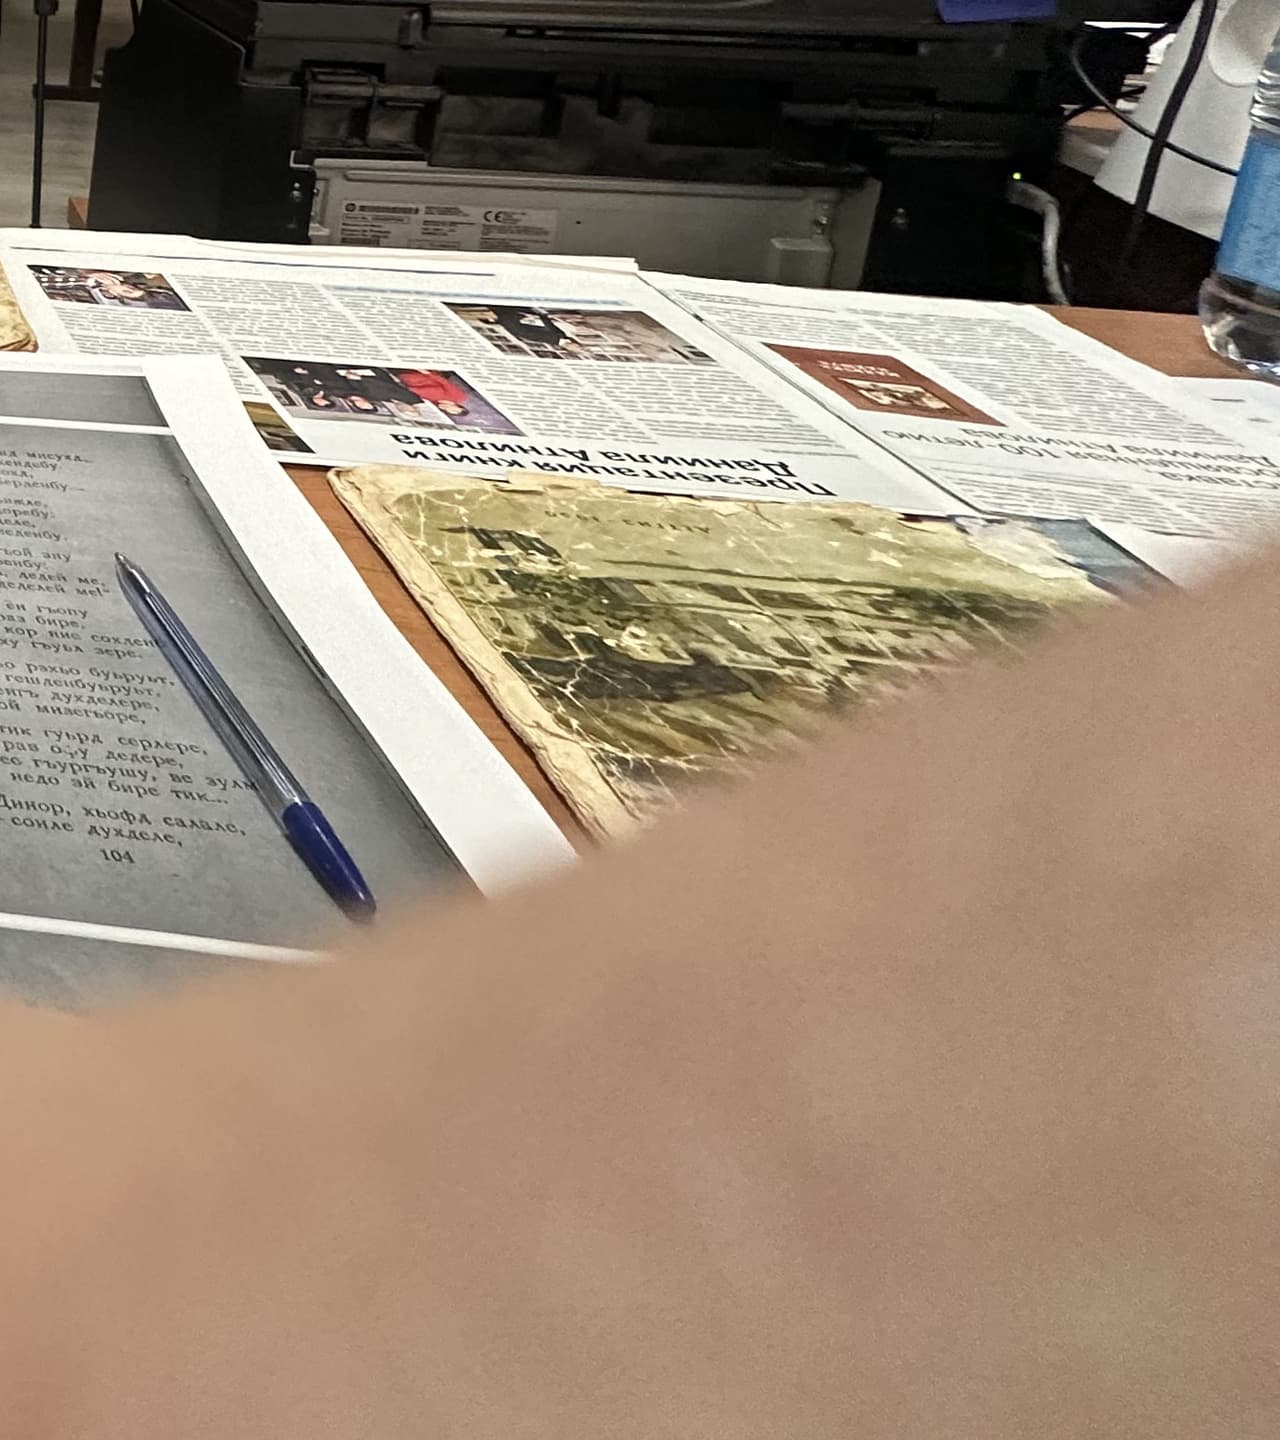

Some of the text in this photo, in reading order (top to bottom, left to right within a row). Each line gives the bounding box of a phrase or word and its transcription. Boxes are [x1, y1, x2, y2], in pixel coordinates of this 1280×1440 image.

[391, 434, 797, 477] Даниила Атнилова
[881, 430, 1280, 477] освященная 100-летию
[962, 429, 1278, 468] Даниила Атнилова
[402, 450, 836, 496] Презентация книги
[1145, 470, 1280, 490] ставка,
